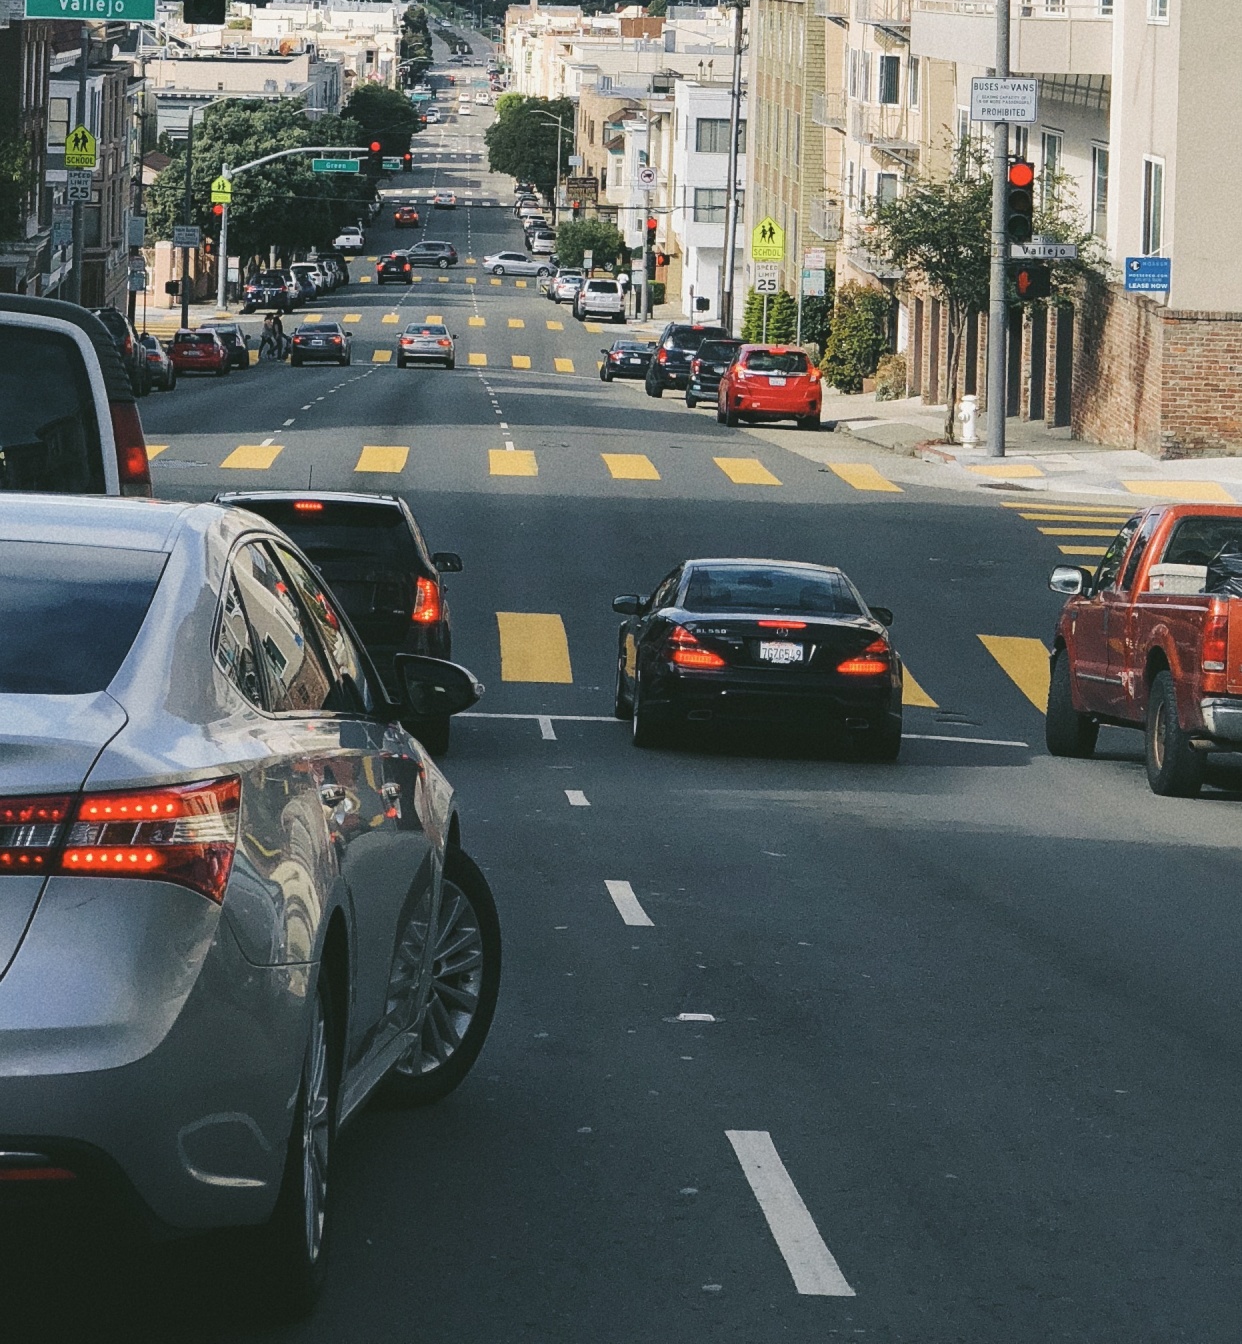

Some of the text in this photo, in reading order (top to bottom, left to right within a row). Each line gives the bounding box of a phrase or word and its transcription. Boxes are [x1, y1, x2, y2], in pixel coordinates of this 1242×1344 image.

[974, 82, 999, 91] BUSES
[982, 108, 1026, 116] PROHIBITED
[66, 157, 94, 165] SCHOOL
[70, 187, 89, 199] 25
[753, 249, 781, 257] SCHOOL
[1022, 246, 1066, 257] Vallejo
[757, 279, 776, 291] 25
